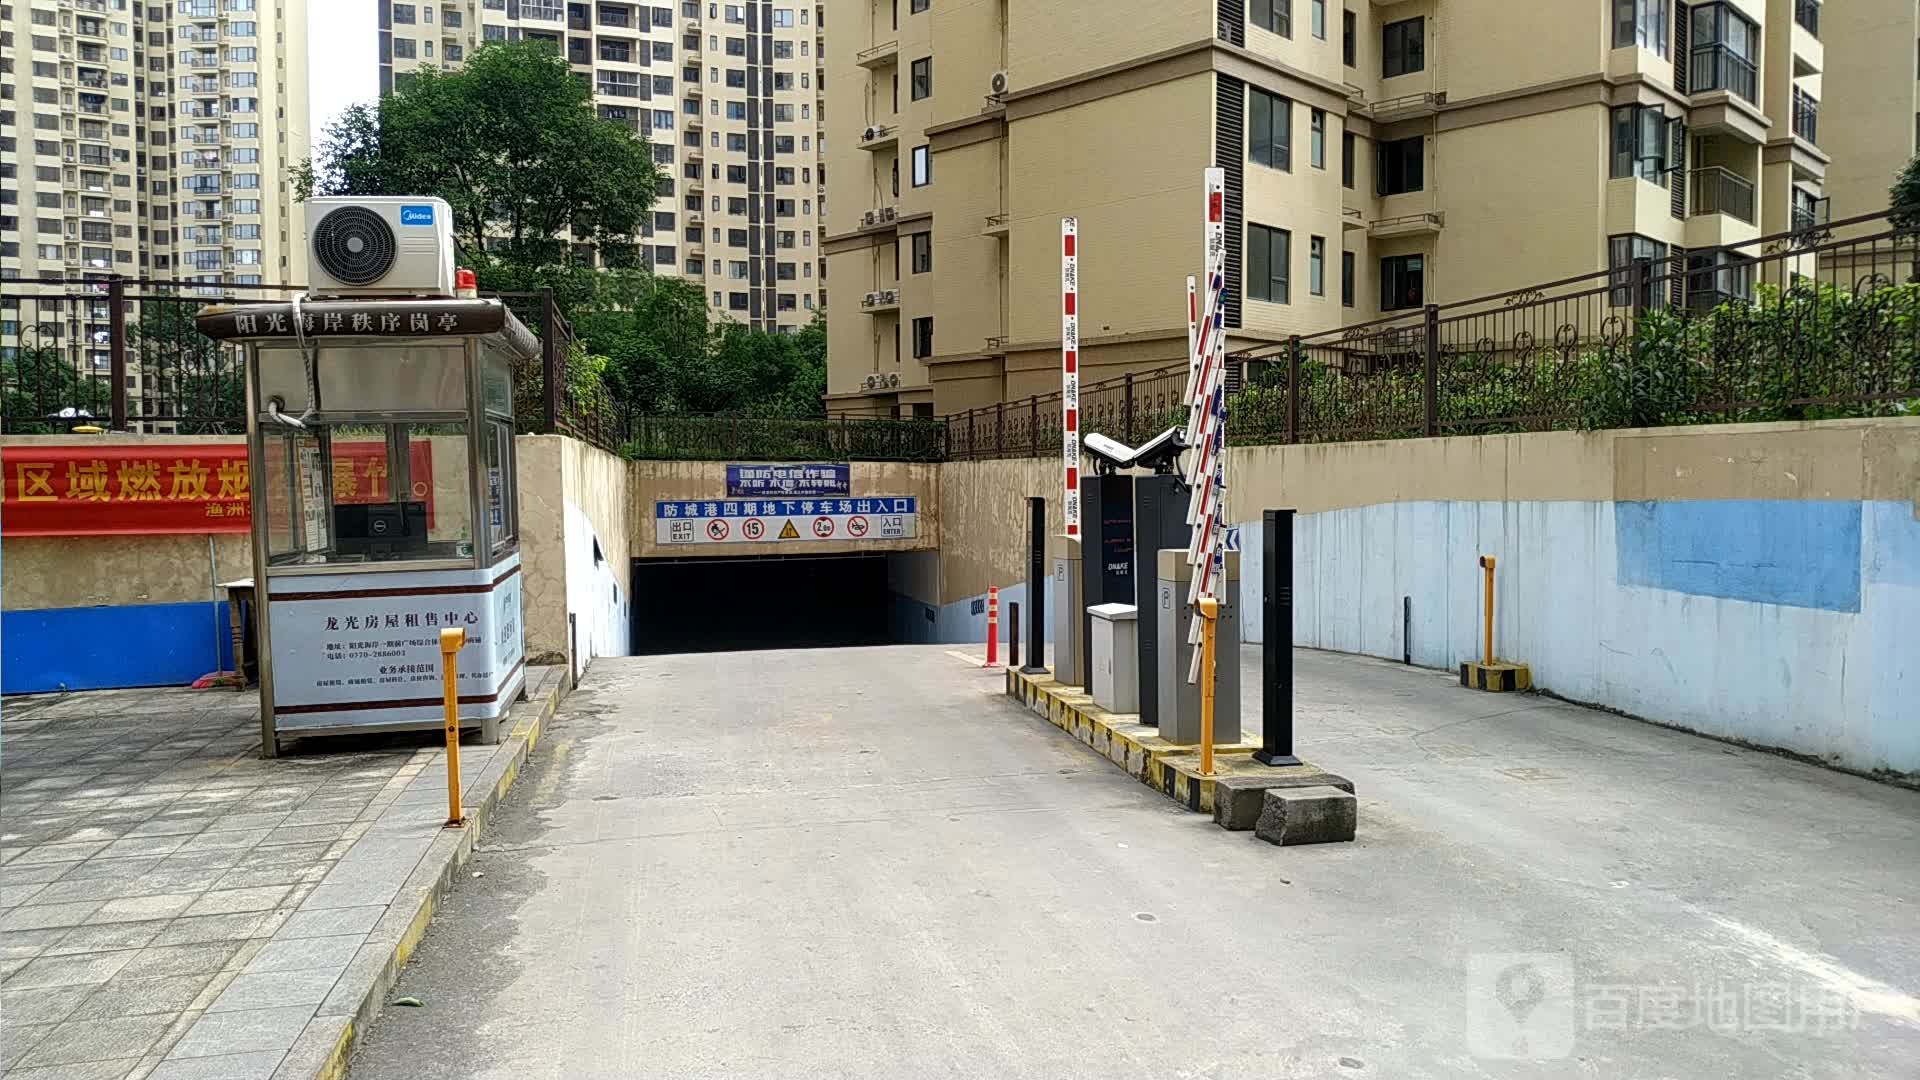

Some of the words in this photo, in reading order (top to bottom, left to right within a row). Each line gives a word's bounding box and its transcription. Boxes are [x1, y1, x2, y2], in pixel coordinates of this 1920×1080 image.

[403, 210, 432, 221] Midea
[205, 502, 252, 517] 渔洲
[663, 498, 909, 517] 防城港四期地下停车场出入口
[672, 521, 692, 532] 出口
[883, 517, 901, 527] 入口
[746, 522, 759, 535] 15
[324, 611, 480, 631] 龙光房屋租售中心
[379, 663, 435, 675] 业务承接范围
